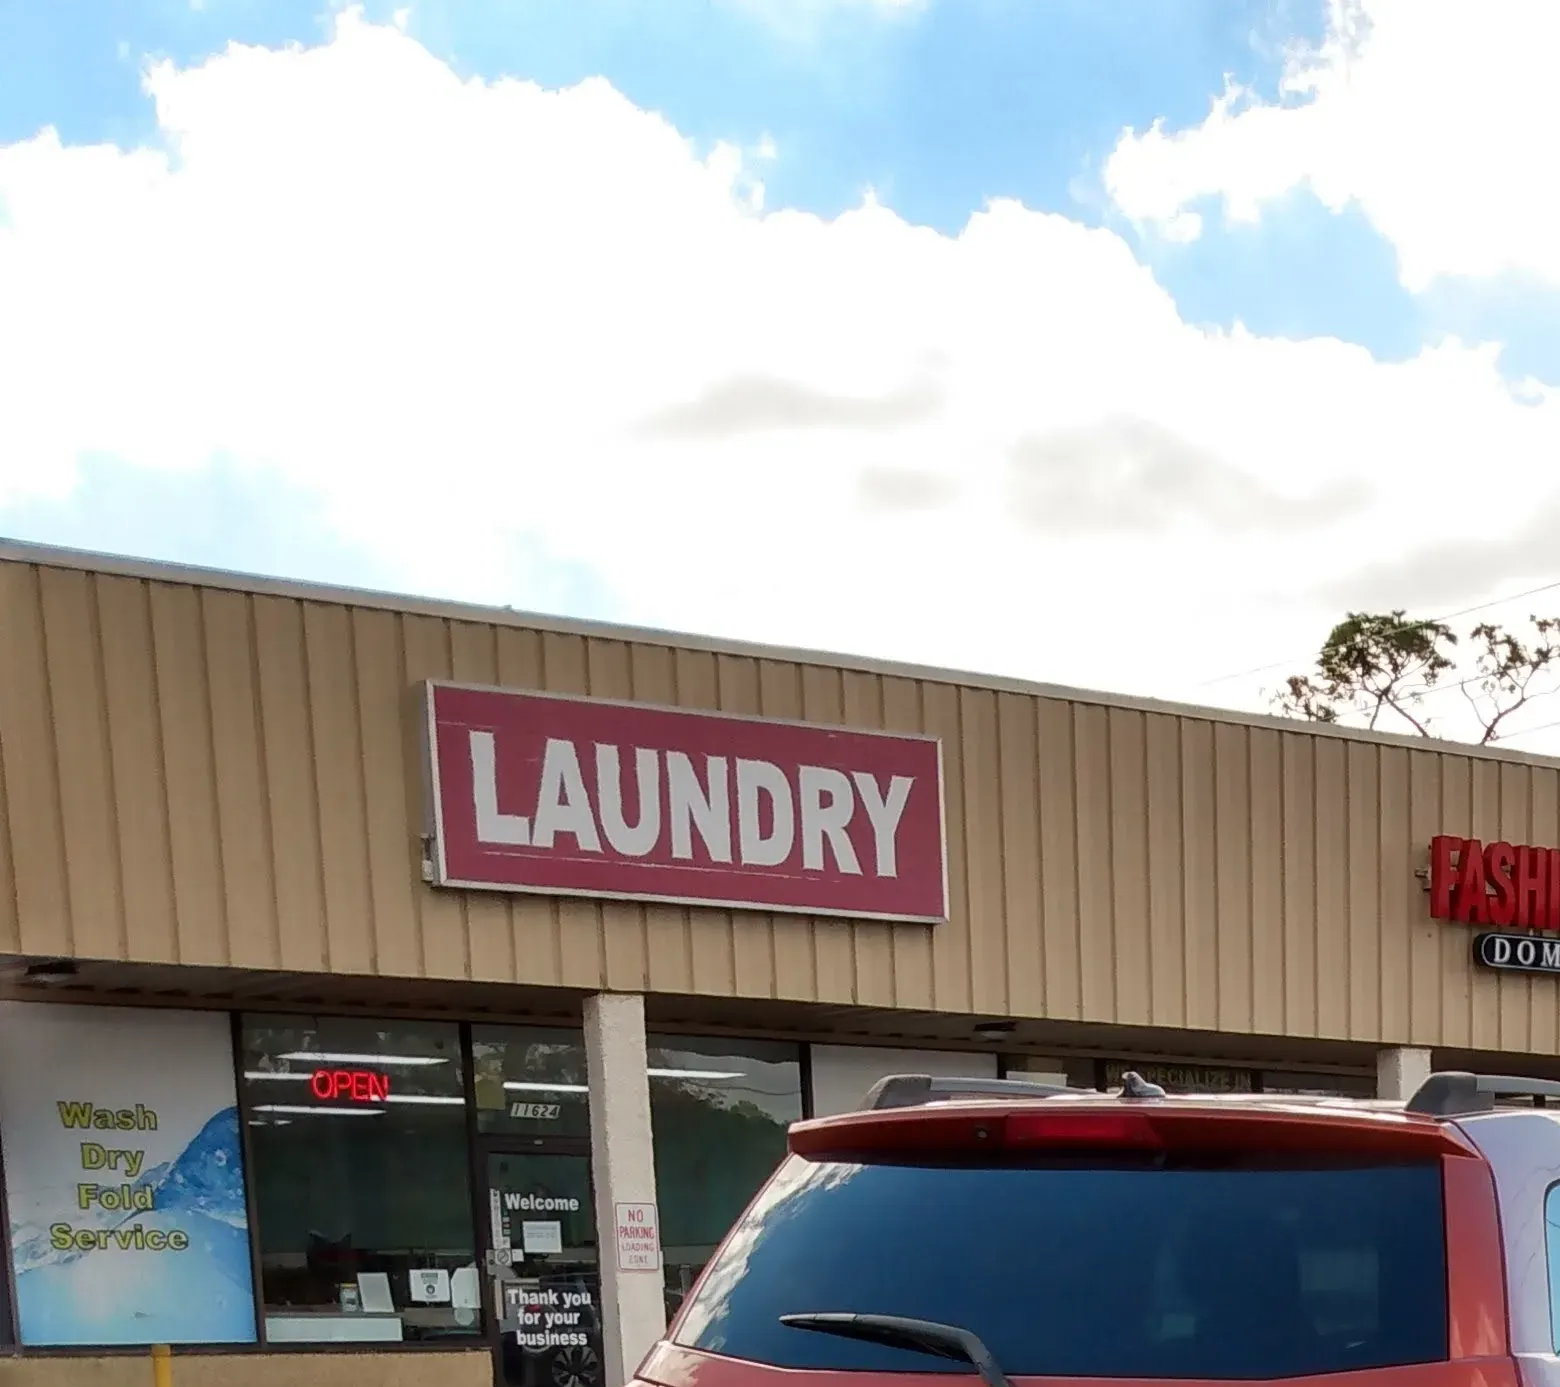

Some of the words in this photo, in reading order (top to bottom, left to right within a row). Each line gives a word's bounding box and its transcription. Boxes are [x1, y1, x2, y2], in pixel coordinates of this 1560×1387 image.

[469, 730, 917, 878] LAUNDRY
[312, 1070, 389, 1101] OPEN
[56, 1101, 157, 1130] Wash
[514, 1103, 558, 1117] 11624
[80, 1142, 144, 1177] Dry
[78, 1183, 154, 1211] Fold
[504, 1193, 580, 1211] Welcome
[628, 1209, 644, 1222] NO
[50, 1222, 189, 1251] Service
[619, 1226, 655, 1239] PARKING
[622, 1242, 655, 1252] LOADING
[507, 1289, 559, 1305] Thank
[563, 1292, 592, 1308] you
[518, 1309, 541, 1325] for
[545, 1312, 581, 1328] your
[516, 1330, 588, 1346] business
